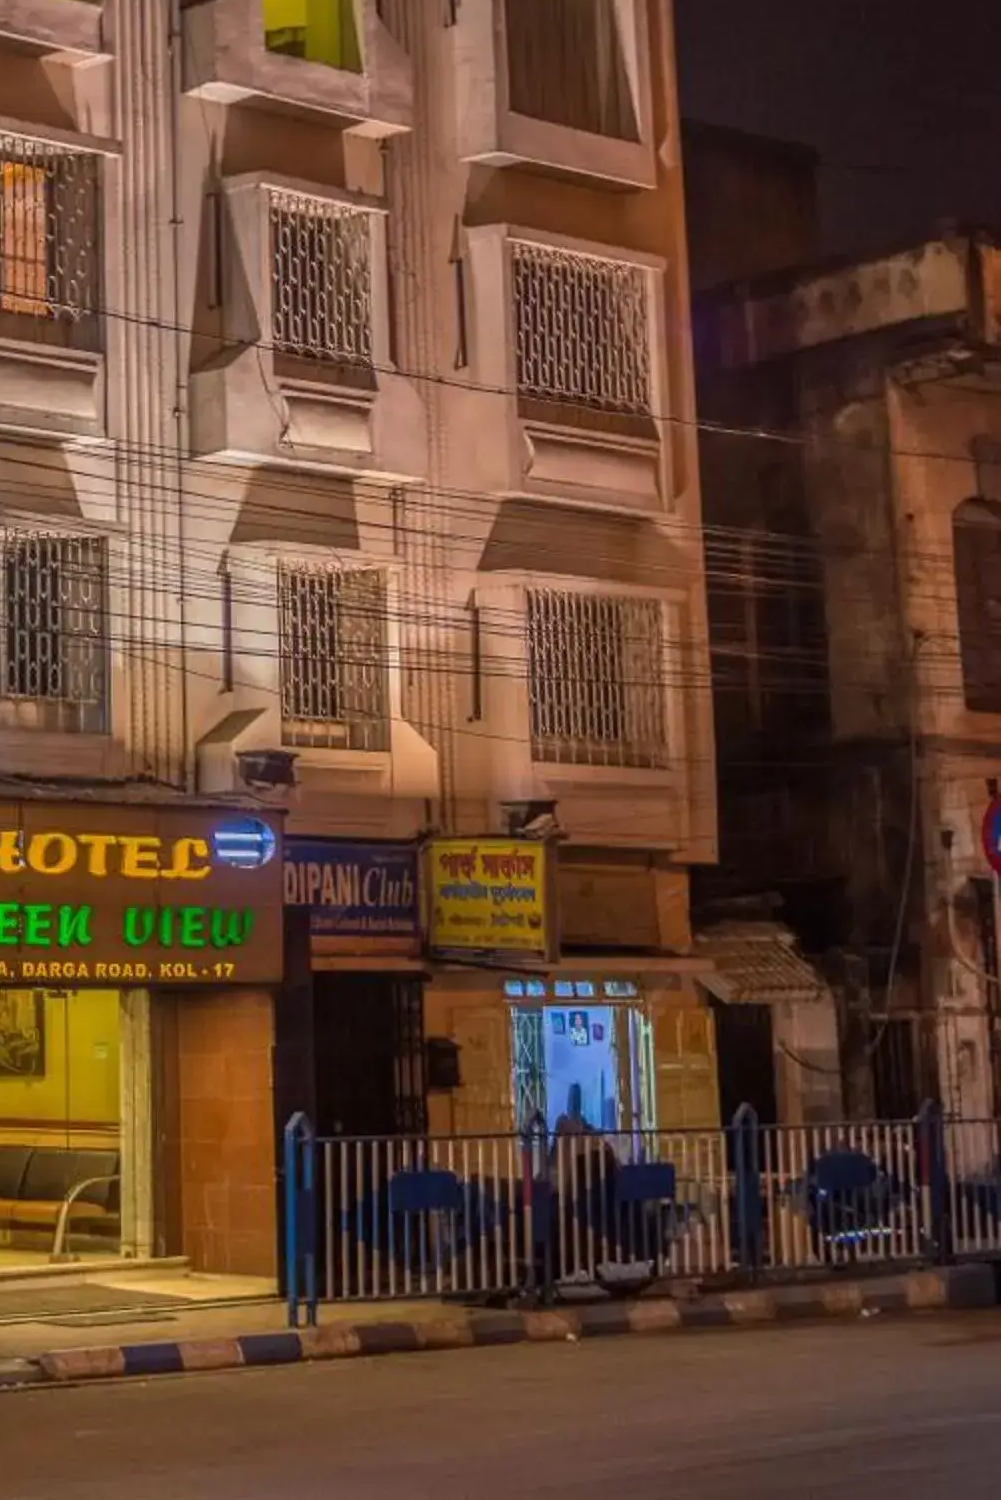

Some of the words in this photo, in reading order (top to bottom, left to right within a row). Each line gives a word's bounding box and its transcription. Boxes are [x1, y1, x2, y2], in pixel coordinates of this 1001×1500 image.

[284, 860, 360, 907] DIPANI
[362, 866, 414, 908] Club
[122, 904, 256, 949] VIEW
[22, 962, 89, 979] DARGA
[95, 963, 152, 980] ROAD,
[160, 963, 199, 979] KOL
[213, 963, 236, 979] 17
